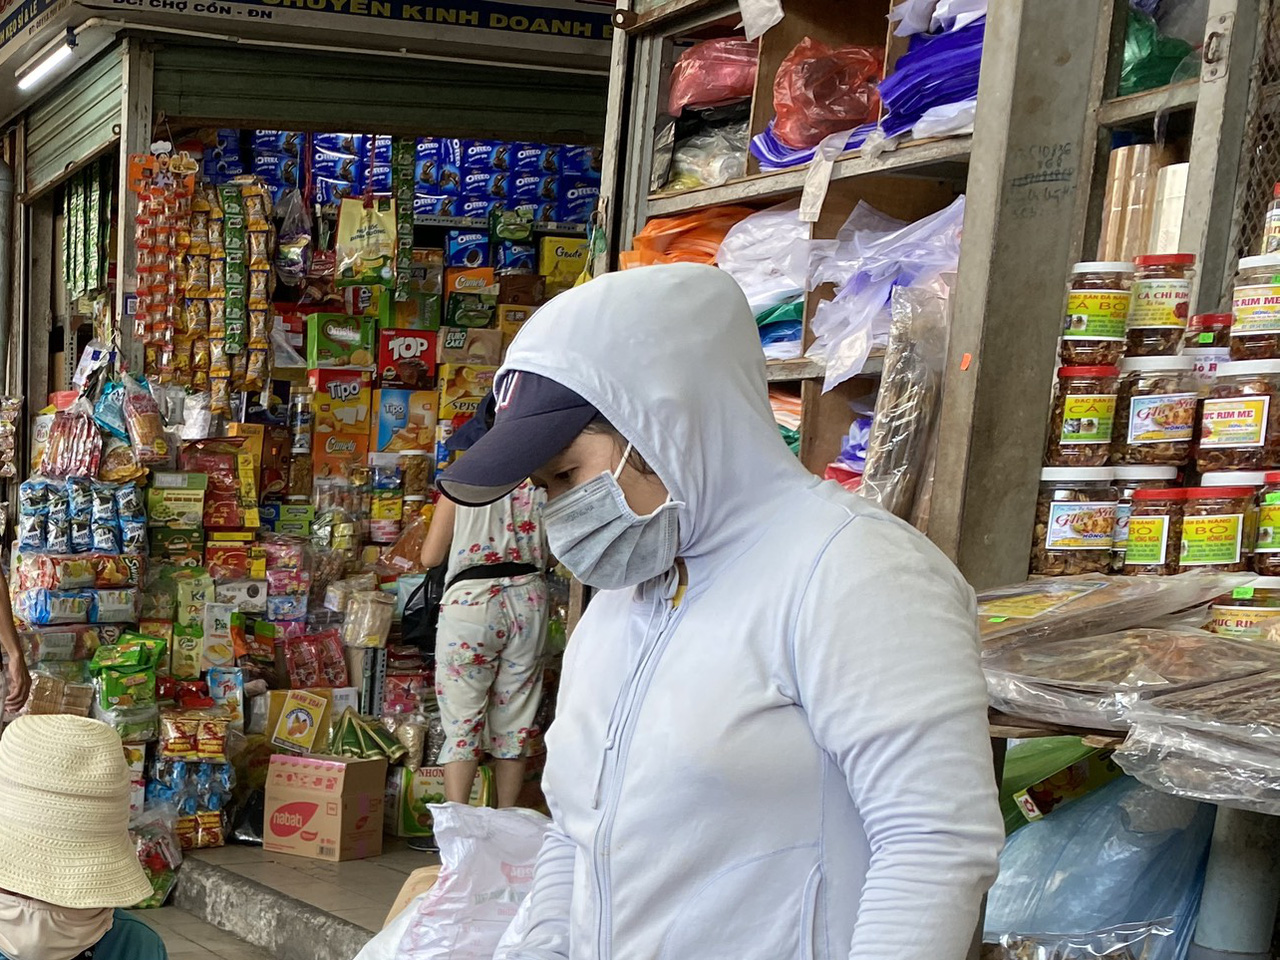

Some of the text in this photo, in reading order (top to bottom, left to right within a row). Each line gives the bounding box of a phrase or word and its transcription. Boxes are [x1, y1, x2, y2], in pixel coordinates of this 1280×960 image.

[402, 4, 479, 25] KINH
[489, 13, 592, 37] DOANH
[388, 336, 429, 361] TOP
[327, 381, 360, 402] Tipo
[384, 403, 405, 415] Tipo
[273, 811, 303, 828] nabati
